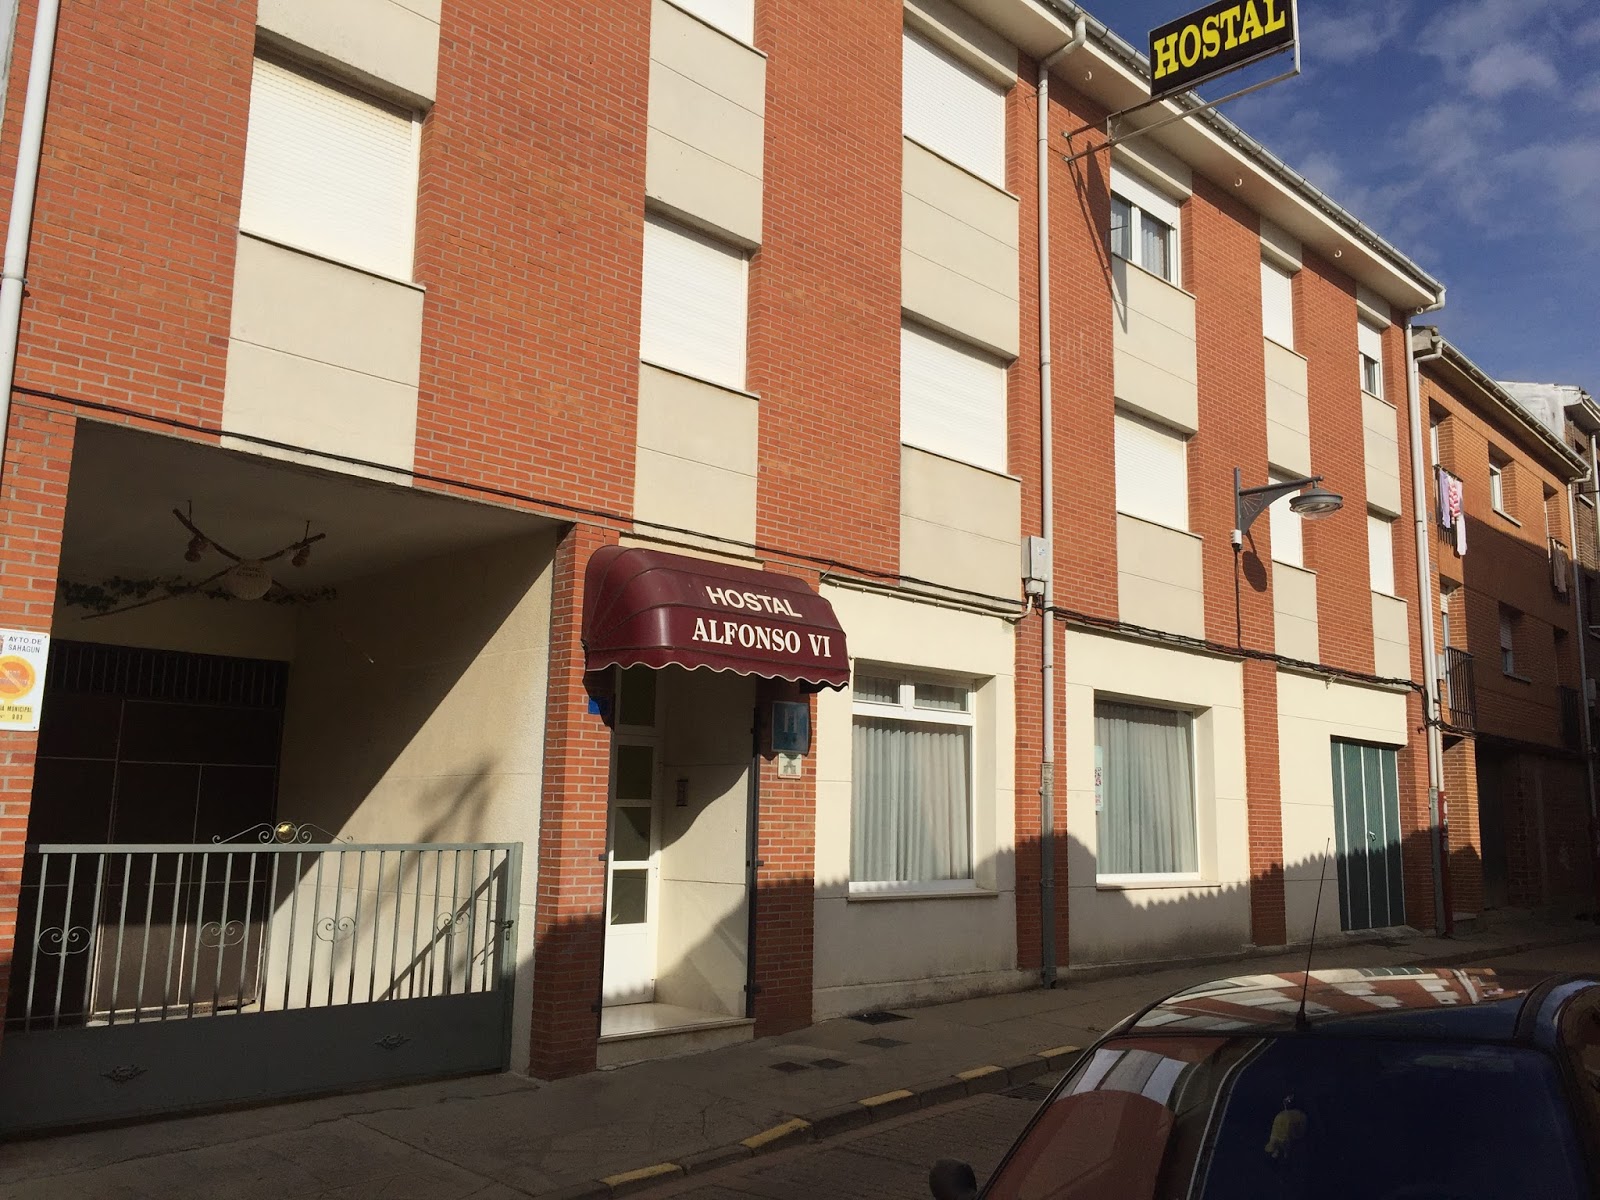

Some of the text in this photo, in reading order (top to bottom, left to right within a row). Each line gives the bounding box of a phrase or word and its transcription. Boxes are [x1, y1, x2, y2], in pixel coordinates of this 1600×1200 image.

[1153, 0, 1286, 80] HOSTAL
[705, 585, 803, 618] HOSTAL
[8, 644, 40, 653] SAHAGUN
[691, 617, 832, 658] ALFONSO VI
[7, 705, 32, 713] MUNICIPAL
